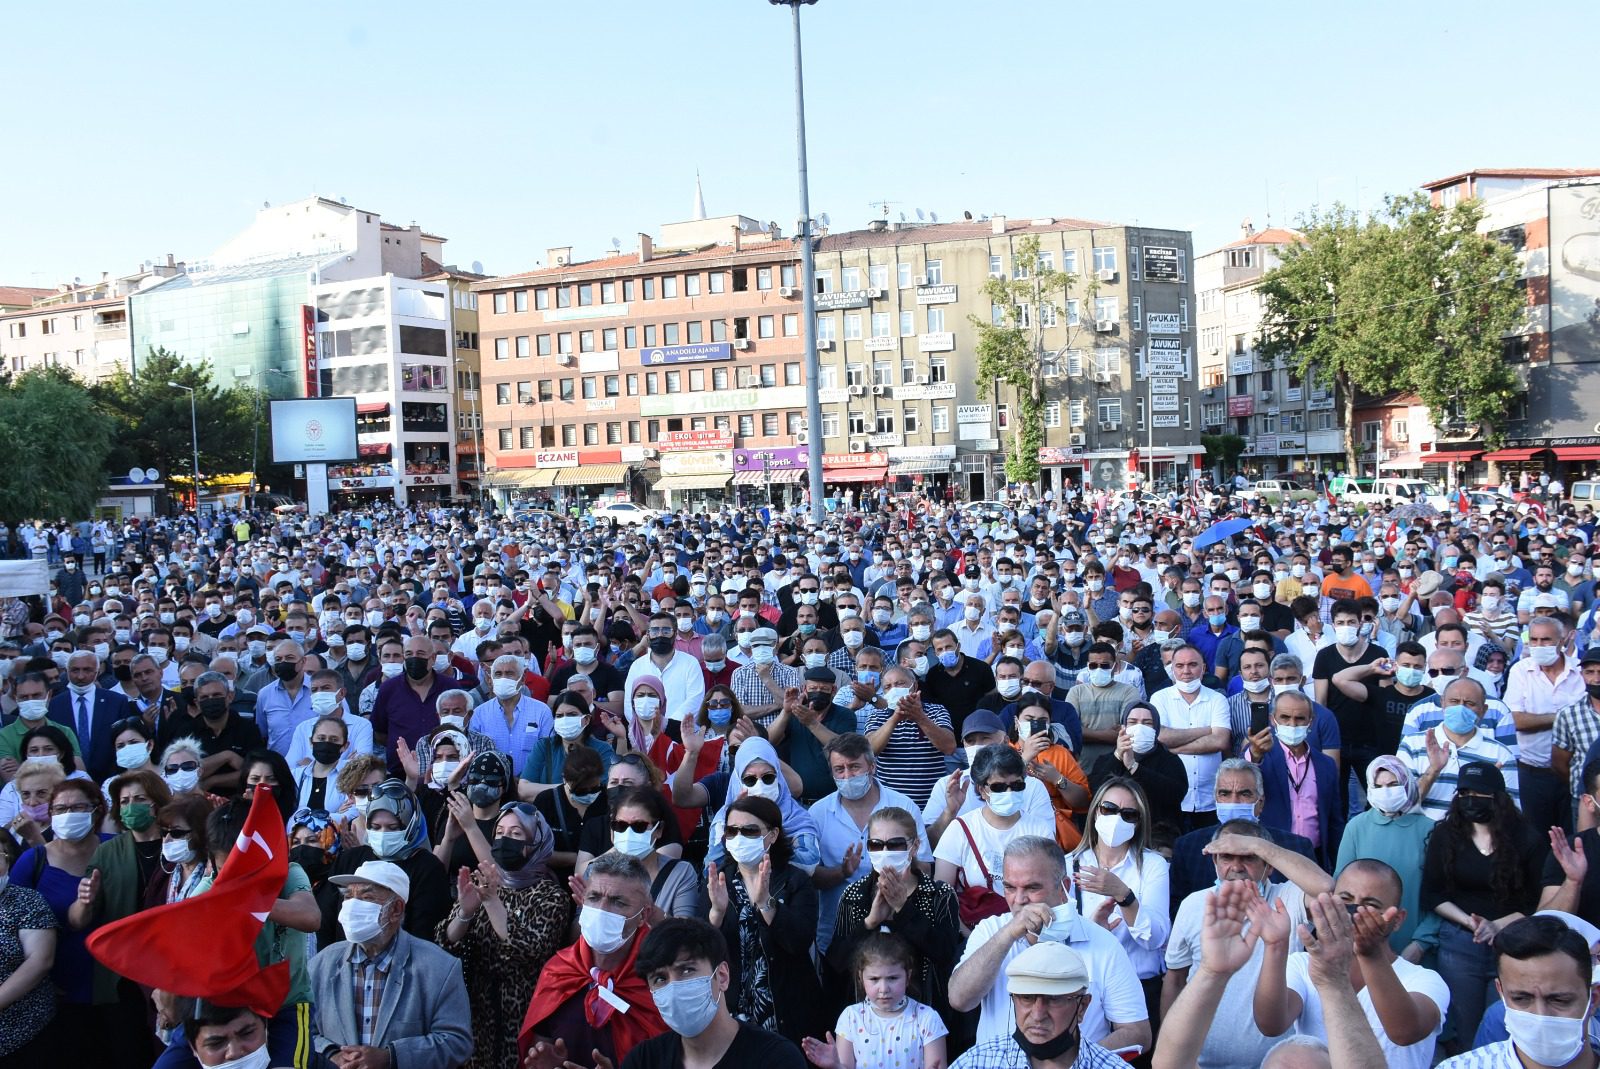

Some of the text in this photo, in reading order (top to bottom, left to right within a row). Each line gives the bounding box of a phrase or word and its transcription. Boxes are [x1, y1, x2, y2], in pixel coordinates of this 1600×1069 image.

[924, 286, 954, 294] AVUKAT
[821, 292, 857, 300] AVUKAT
[1148, 314, 1179, 323] AVUKAT
[1154, 340, 1180, 348] AVUKAT
[666, 346, 720, 356] ANADOLU AJANSI
[958, 405, 991, 414] AVUKAT
[674, 432, 692, 440] EKOL
[537, 452, 576, 463] ECZANE
[828, 454, 866, 464] FAKİHE
